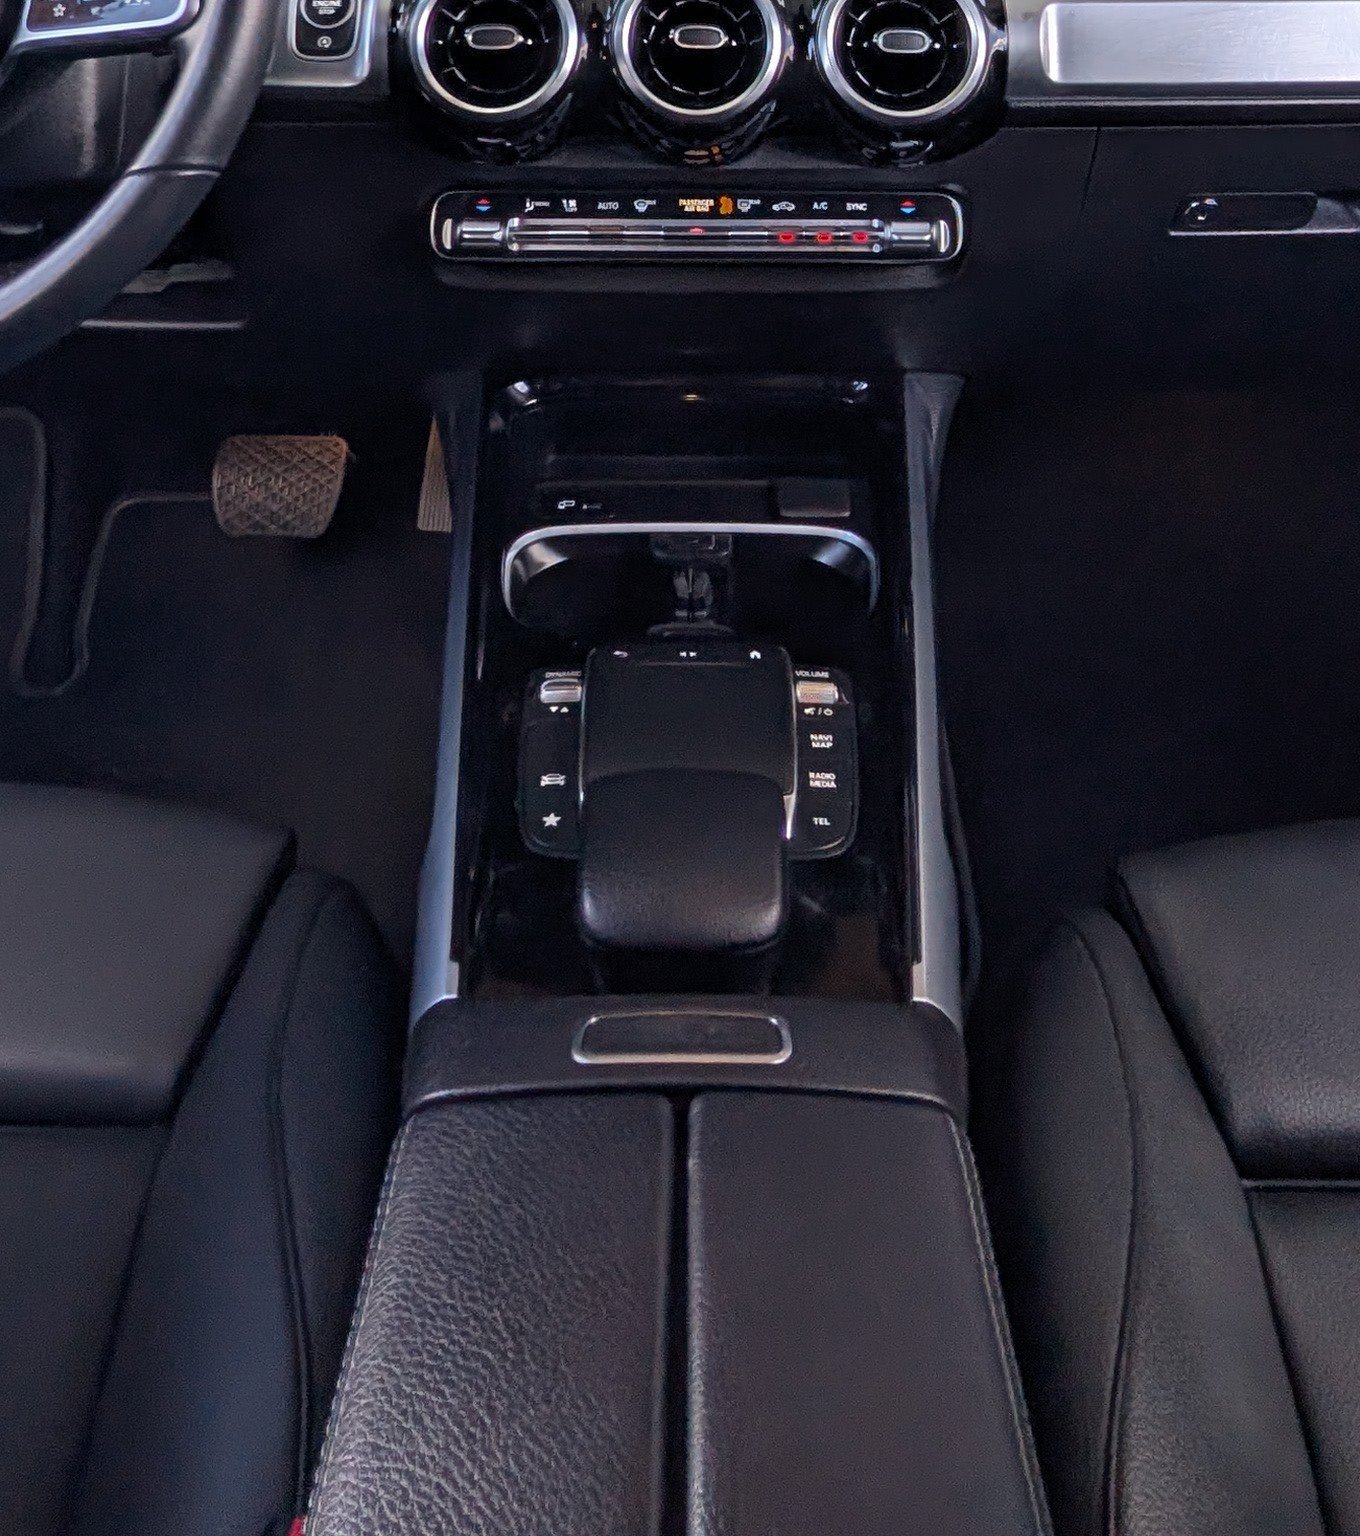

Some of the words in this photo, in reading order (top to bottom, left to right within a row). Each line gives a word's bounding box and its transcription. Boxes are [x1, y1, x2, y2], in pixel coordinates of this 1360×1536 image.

[597, 202, 619, 211] AUTO
[679, 199, 715, 207] PASSENGER
[812, 202, 828, 211] A/C
[846, 202, 868, 211] SYNC
[795, 670, 830, 678] VOLUME
[810, 734, 834, 742] NAVI
[811, 741, 834, 749] MAP
[809, 772, 836, 780] RADIO
[809, 780, 837, 789] MEDIA
[812, 817, 831, 826] TEL
